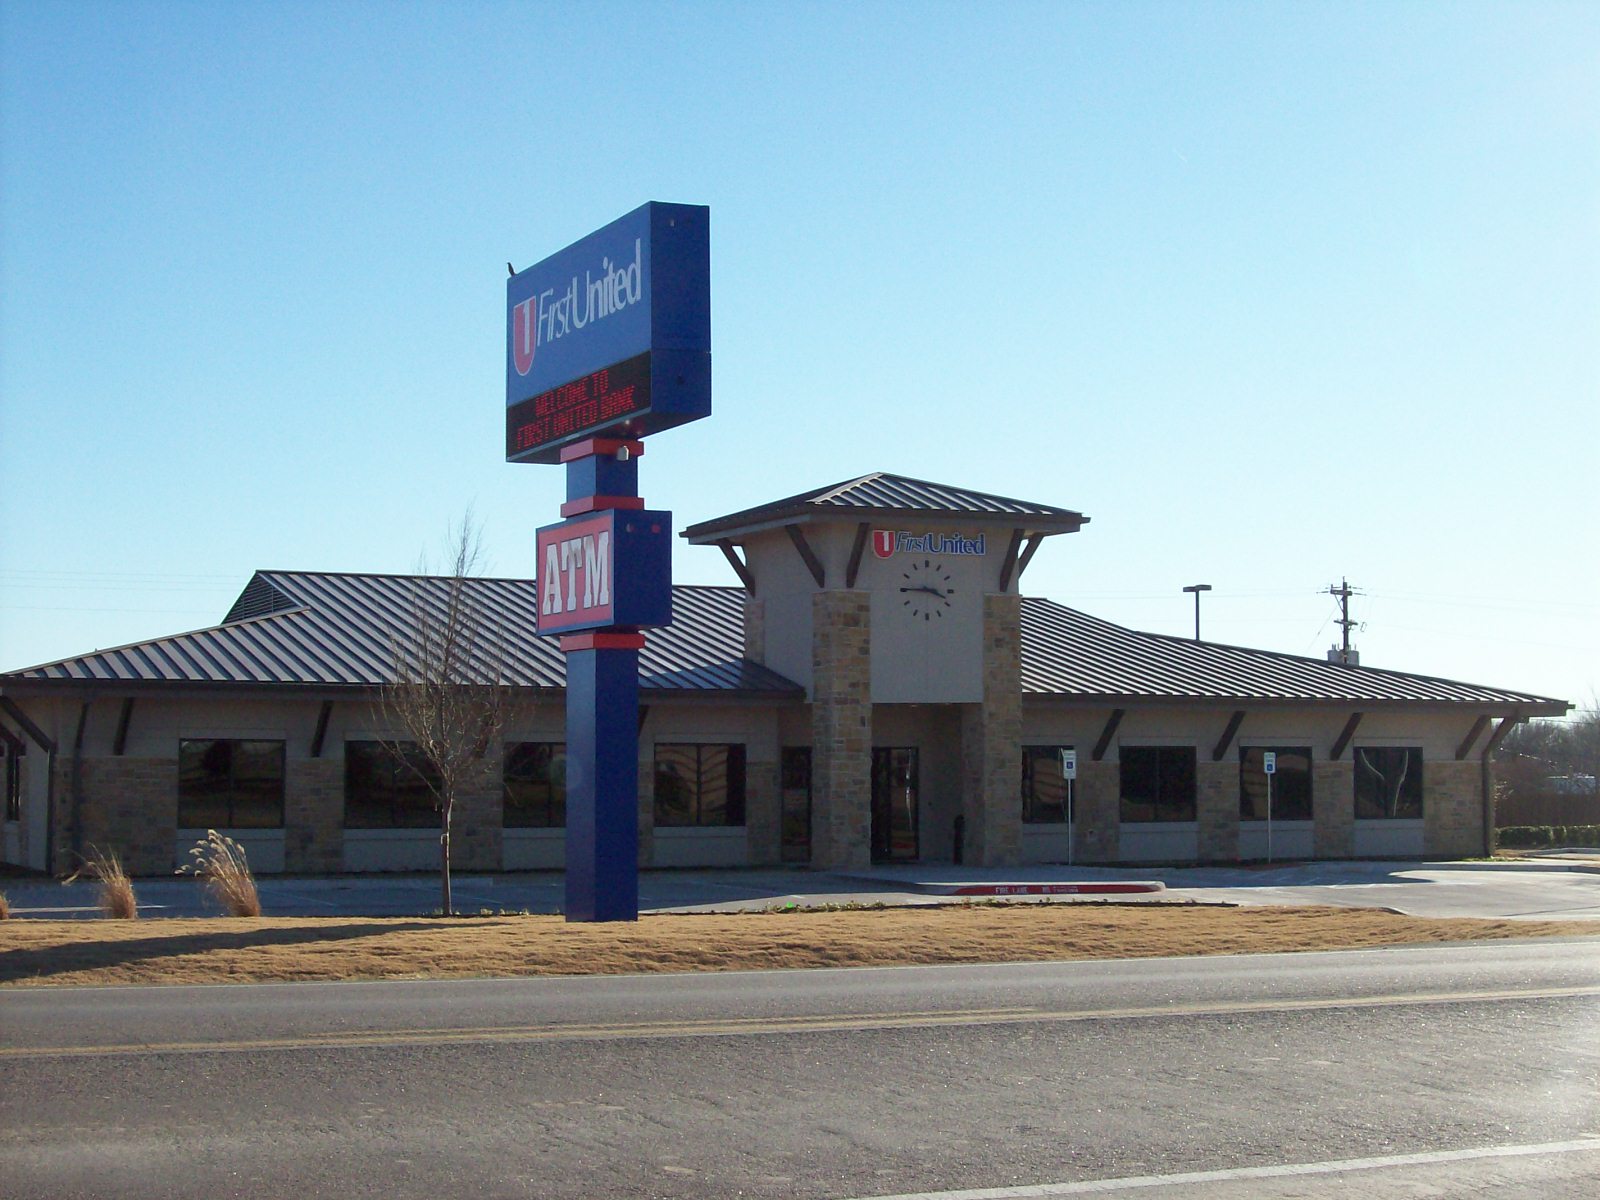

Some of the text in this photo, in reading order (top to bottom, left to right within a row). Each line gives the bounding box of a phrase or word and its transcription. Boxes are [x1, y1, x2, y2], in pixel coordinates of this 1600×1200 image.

[516, 385, 636, 450] FIRST UNITED BANK
[535, 369, 609, 417] WELCOME TO
[542, 531, 609, 615] ATM
